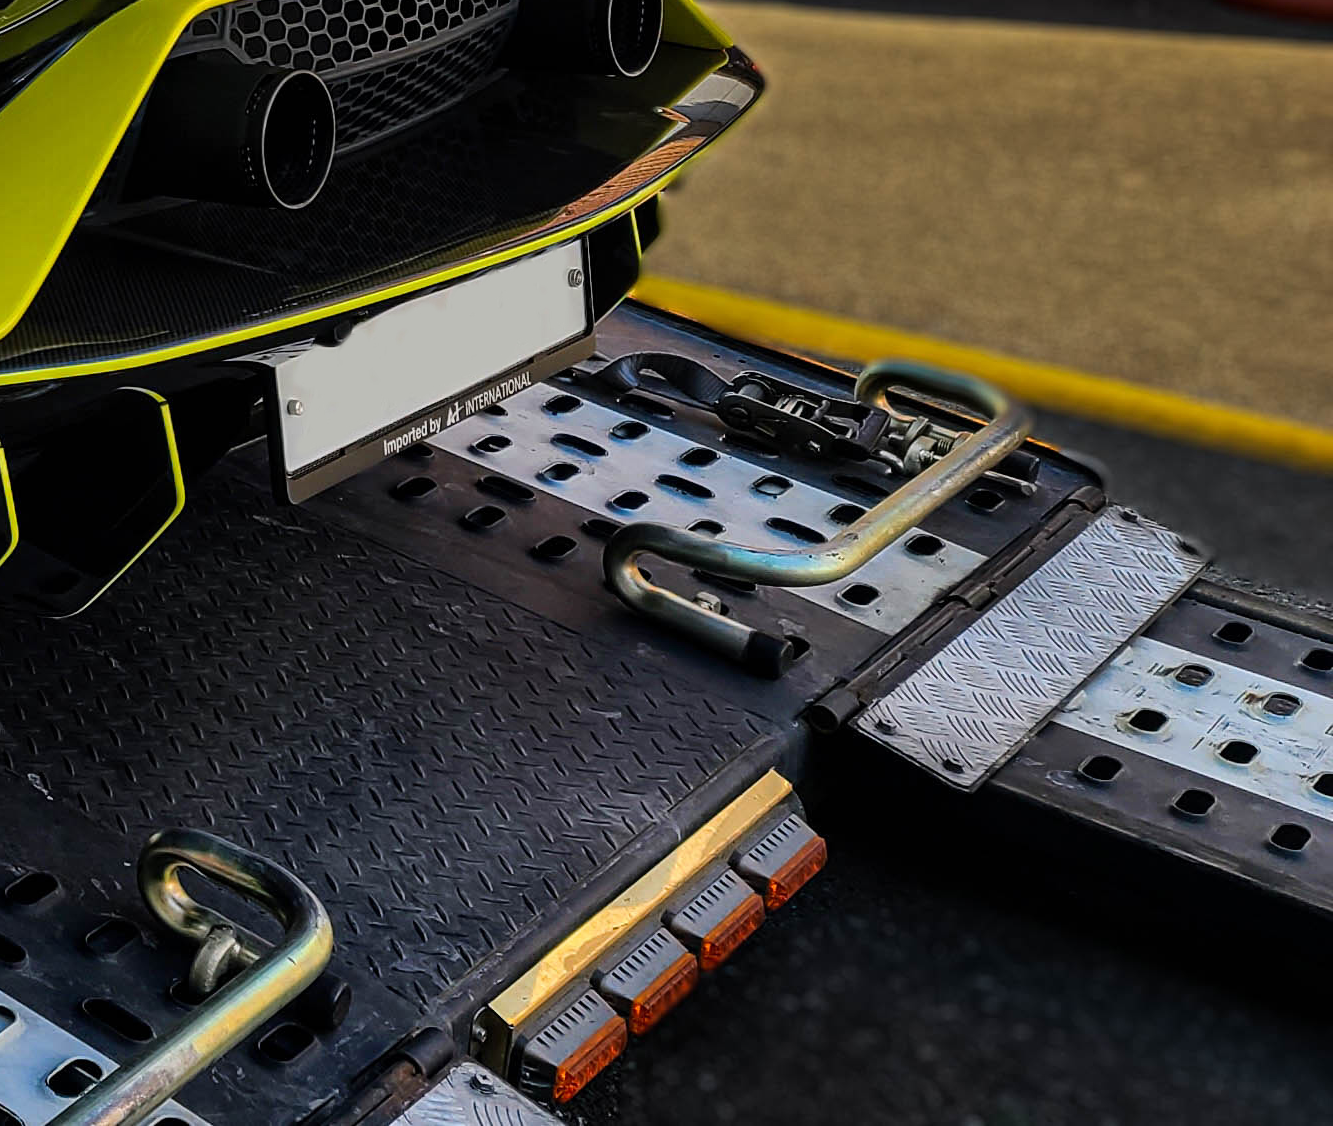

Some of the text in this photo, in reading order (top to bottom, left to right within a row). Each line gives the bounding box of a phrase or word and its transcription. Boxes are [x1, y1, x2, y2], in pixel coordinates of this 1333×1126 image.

[383, 421, 428, 457] Imported
[429, 417, 442, 435] by
[465, 371, 532, 416] INTERNATIONAL
